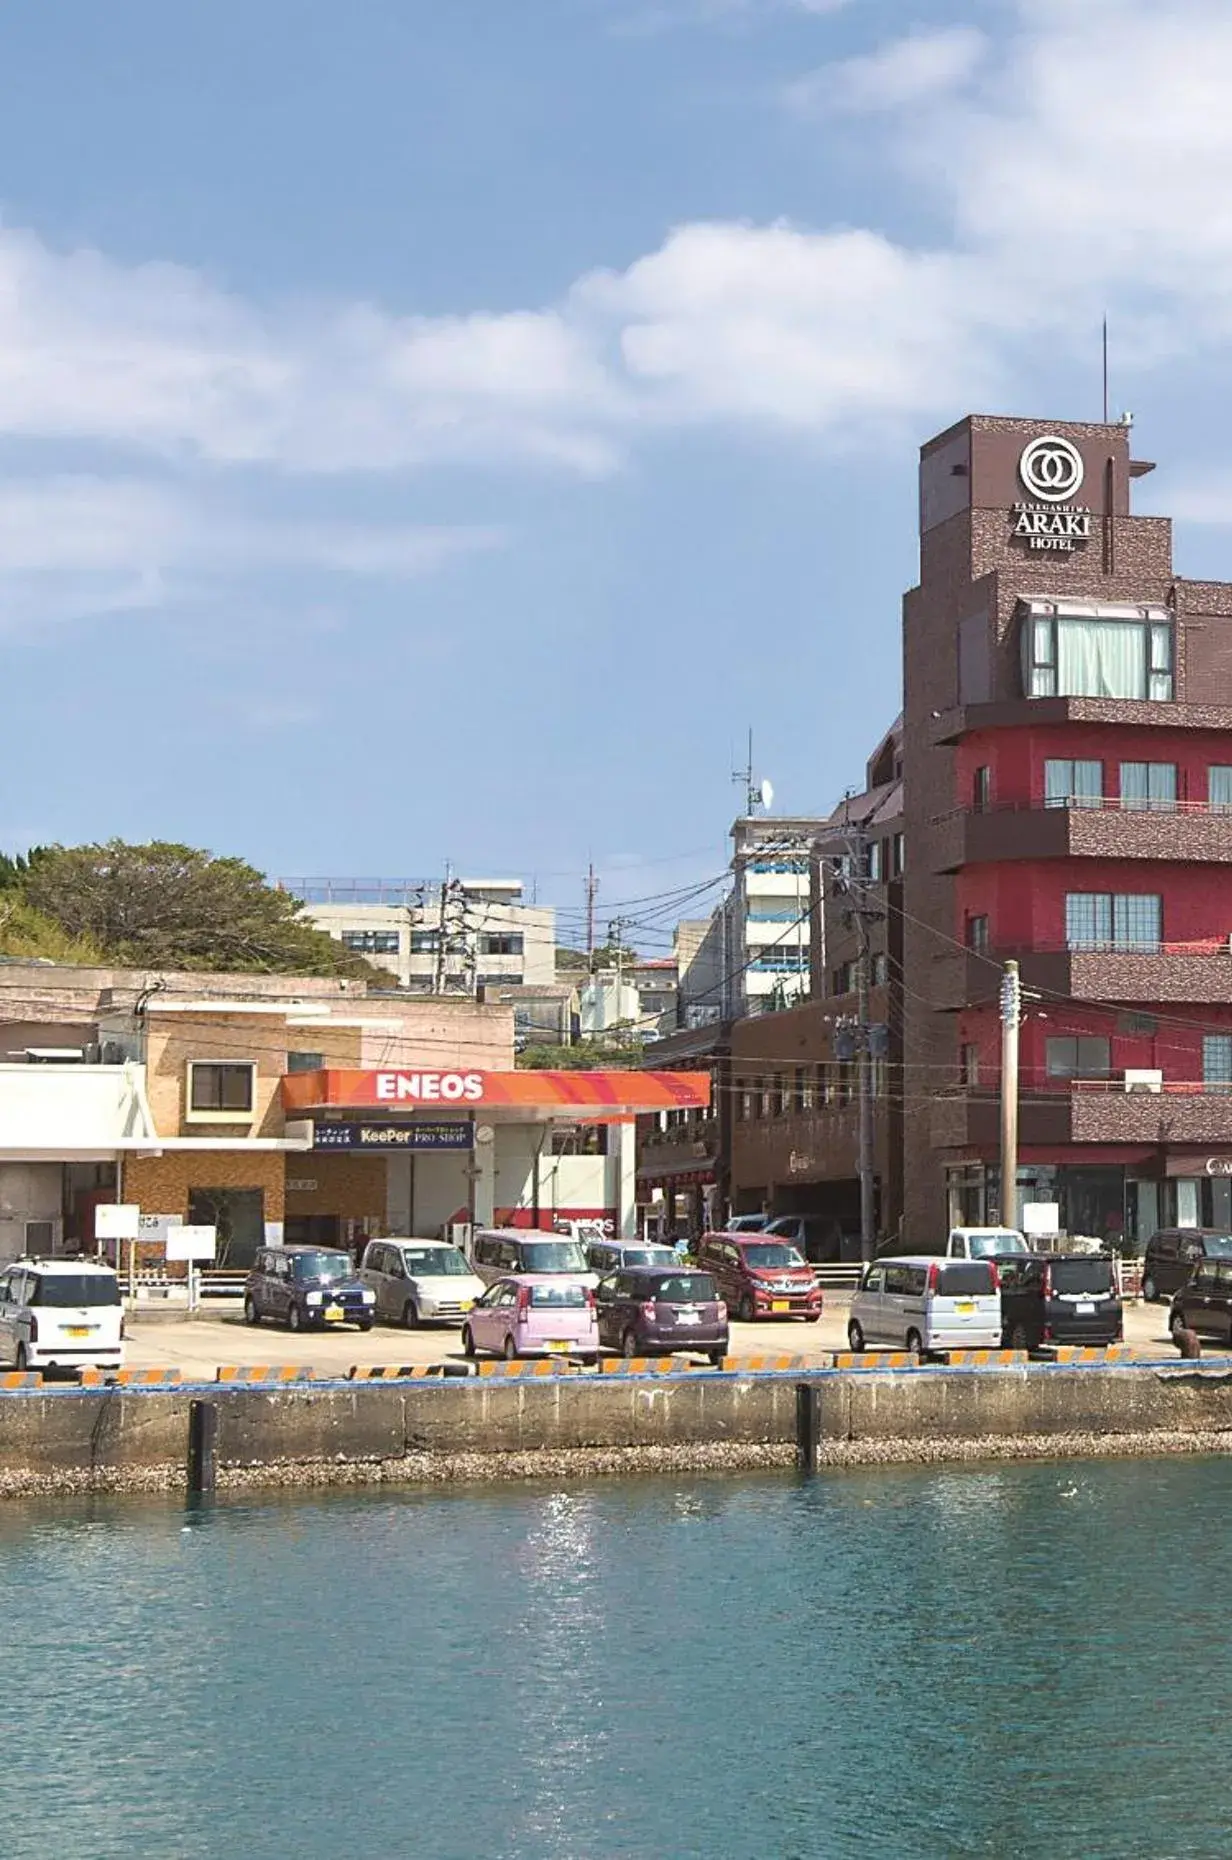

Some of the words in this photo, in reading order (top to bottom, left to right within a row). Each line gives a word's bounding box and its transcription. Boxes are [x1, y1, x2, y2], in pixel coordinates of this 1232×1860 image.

[1014, 512, 1090, 536] ARAKI
[1030, 537, 1075, 551] HOTEL
[376, 1073, 484, 1100] ENEOS
[361, 1127, 411, 1144] KeePer
